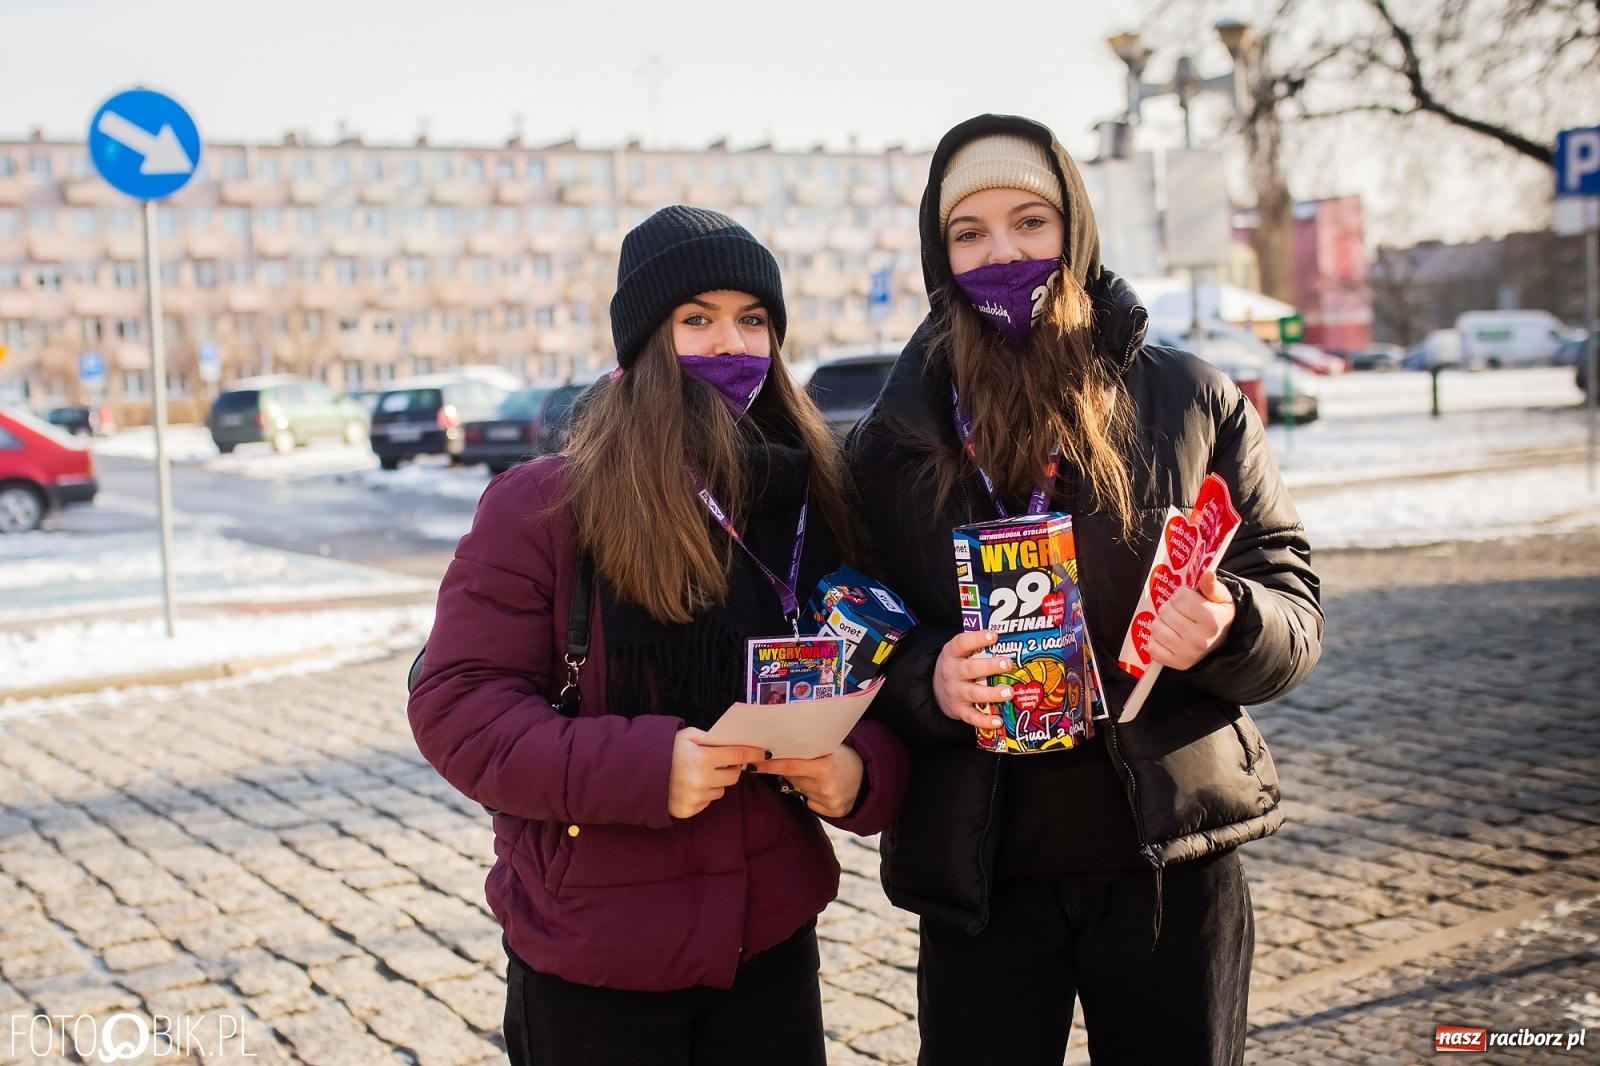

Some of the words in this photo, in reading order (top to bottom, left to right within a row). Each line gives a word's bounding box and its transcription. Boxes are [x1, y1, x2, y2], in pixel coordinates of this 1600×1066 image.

[1565, 133, 1600, 189] P
[988, 571, 1051, 632] 29
[839, 622, 861, 638] onet
[759, 646, 838, 661] WYGRYWAMY
[759, 661, 781, 679] 29
